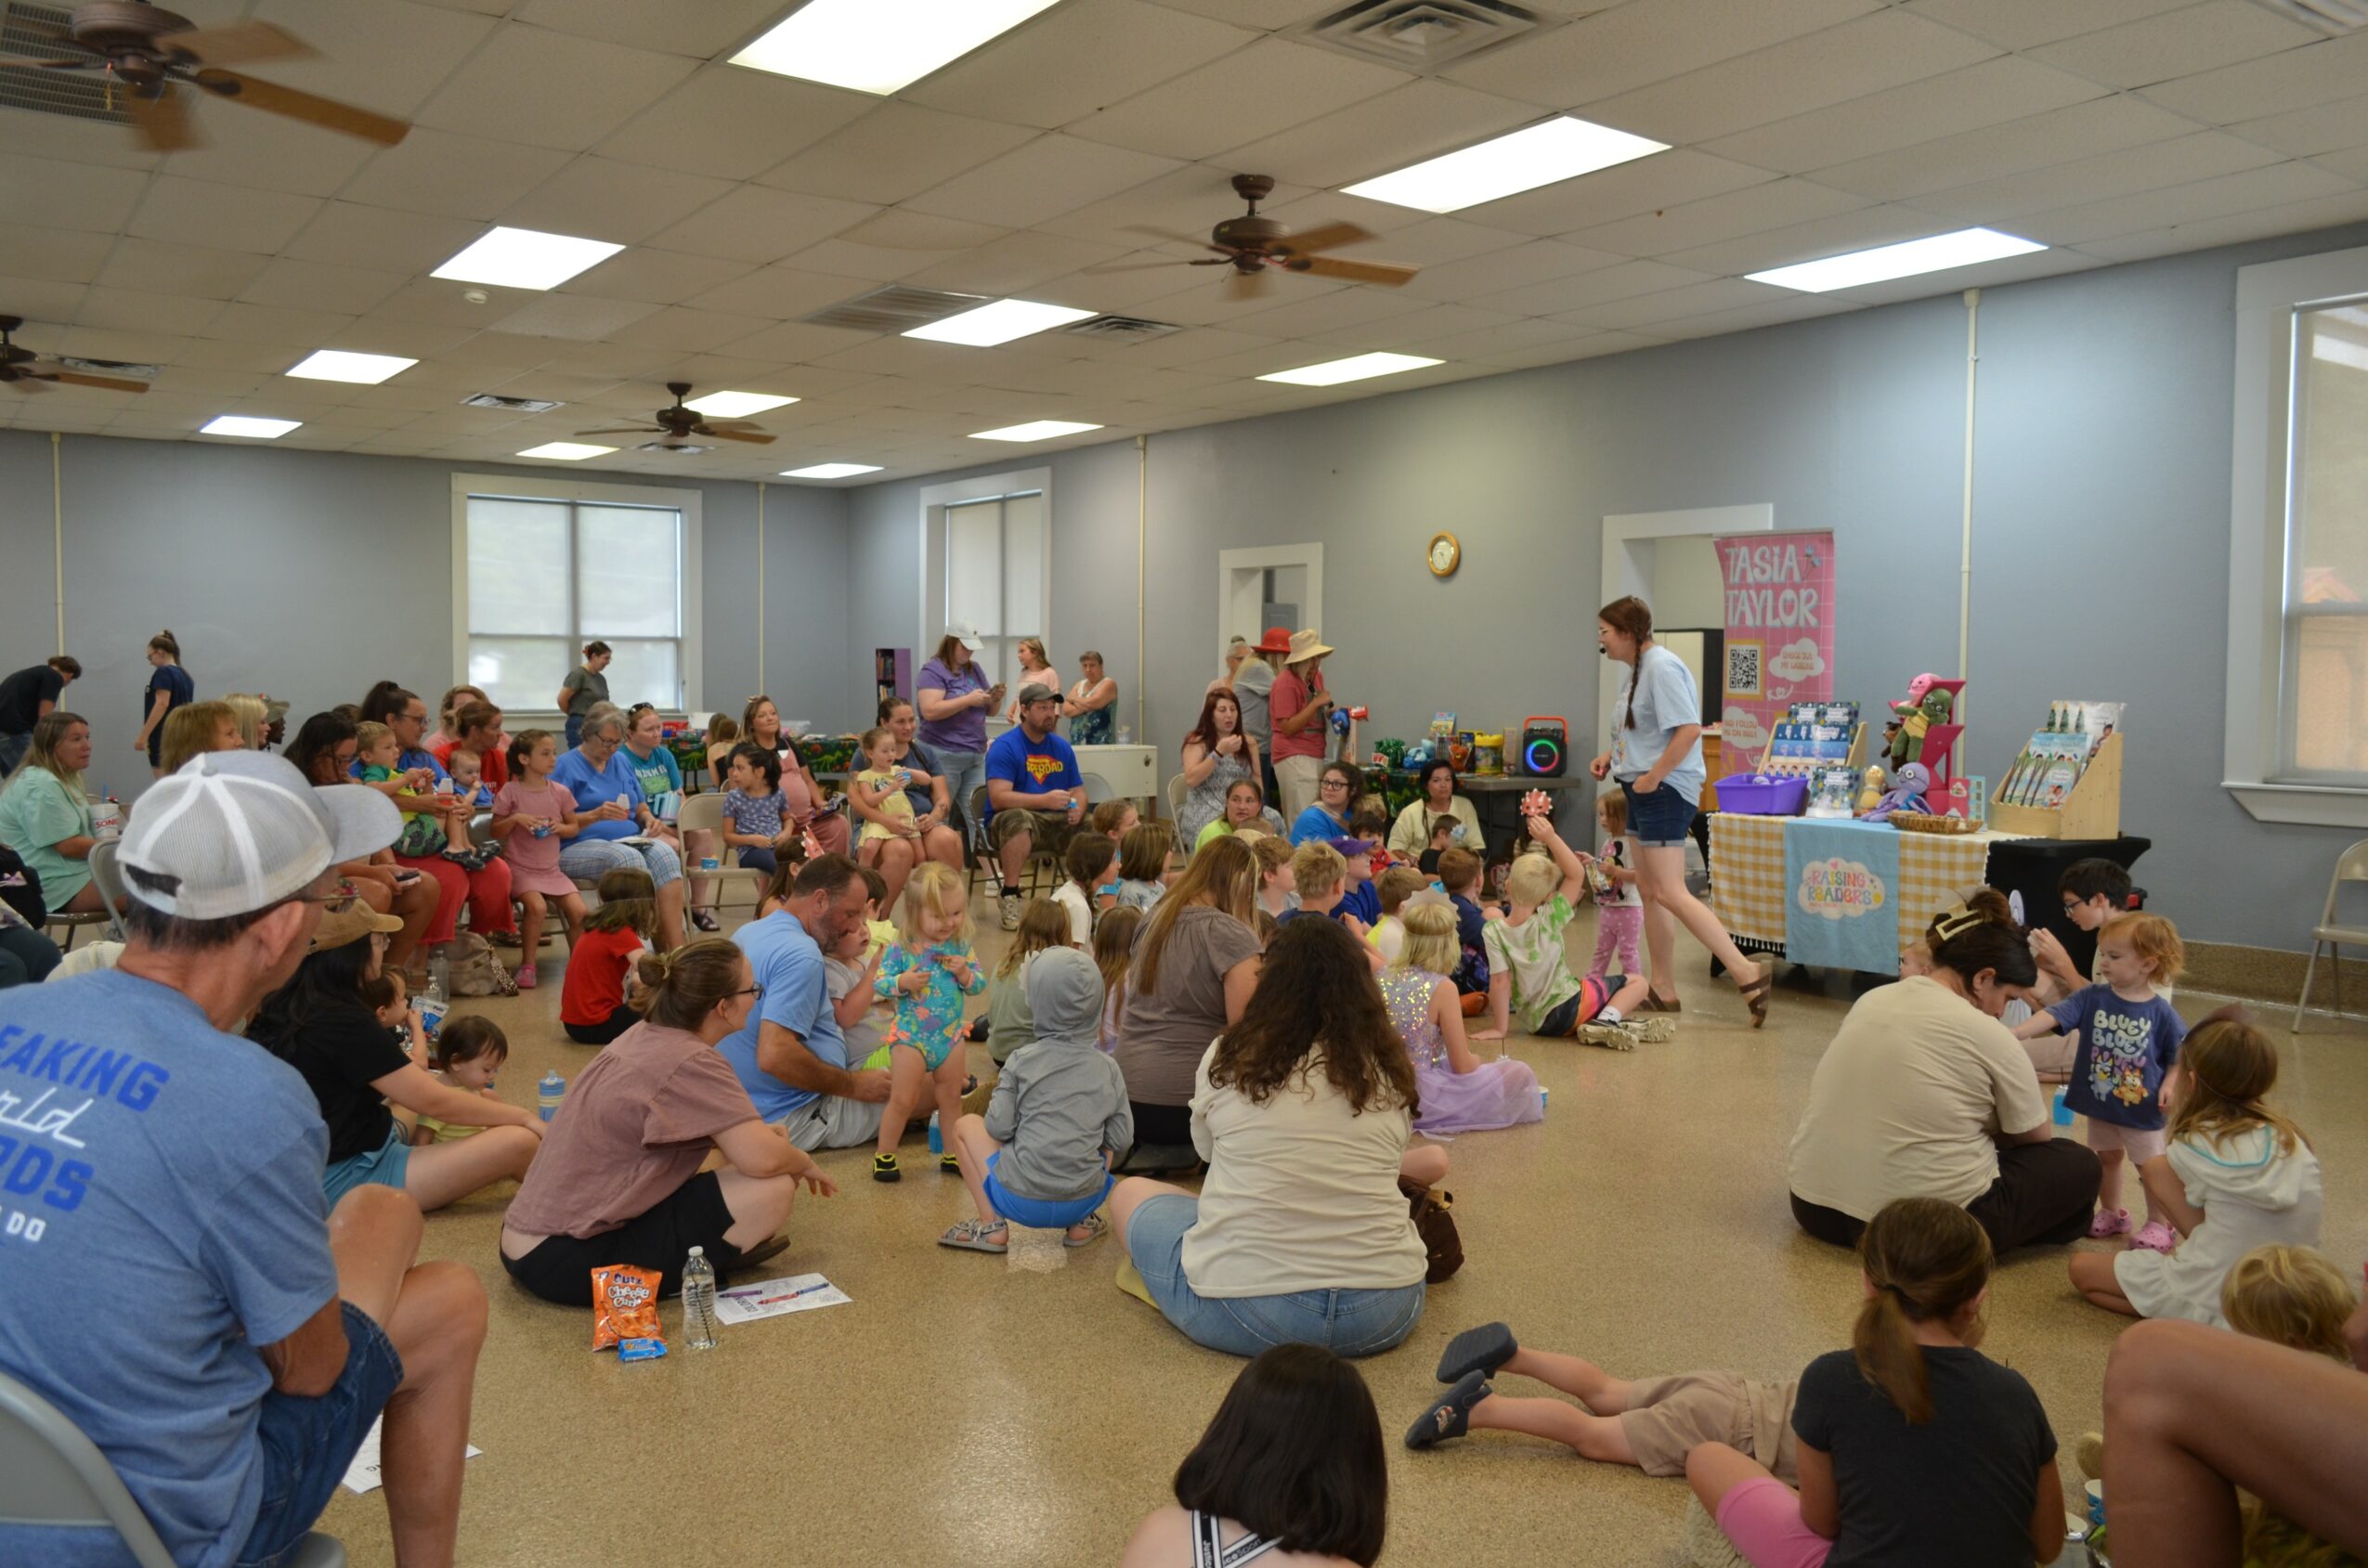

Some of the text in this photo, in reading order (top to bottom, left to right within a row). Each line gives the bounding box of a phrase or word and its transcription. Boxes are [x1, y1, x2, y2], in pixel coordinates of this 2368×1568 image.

[1724, 544, 1802, 585] TASIA
[1725, 588, 1820, 629] TAYLOR
[1812, 870, 1866, 888] RAISING
[2094, 1010, 2152, 1038] BLUEY
[6, 1211, 46, 1242] DO
[608, 1286, 649, 1299] Cheese
